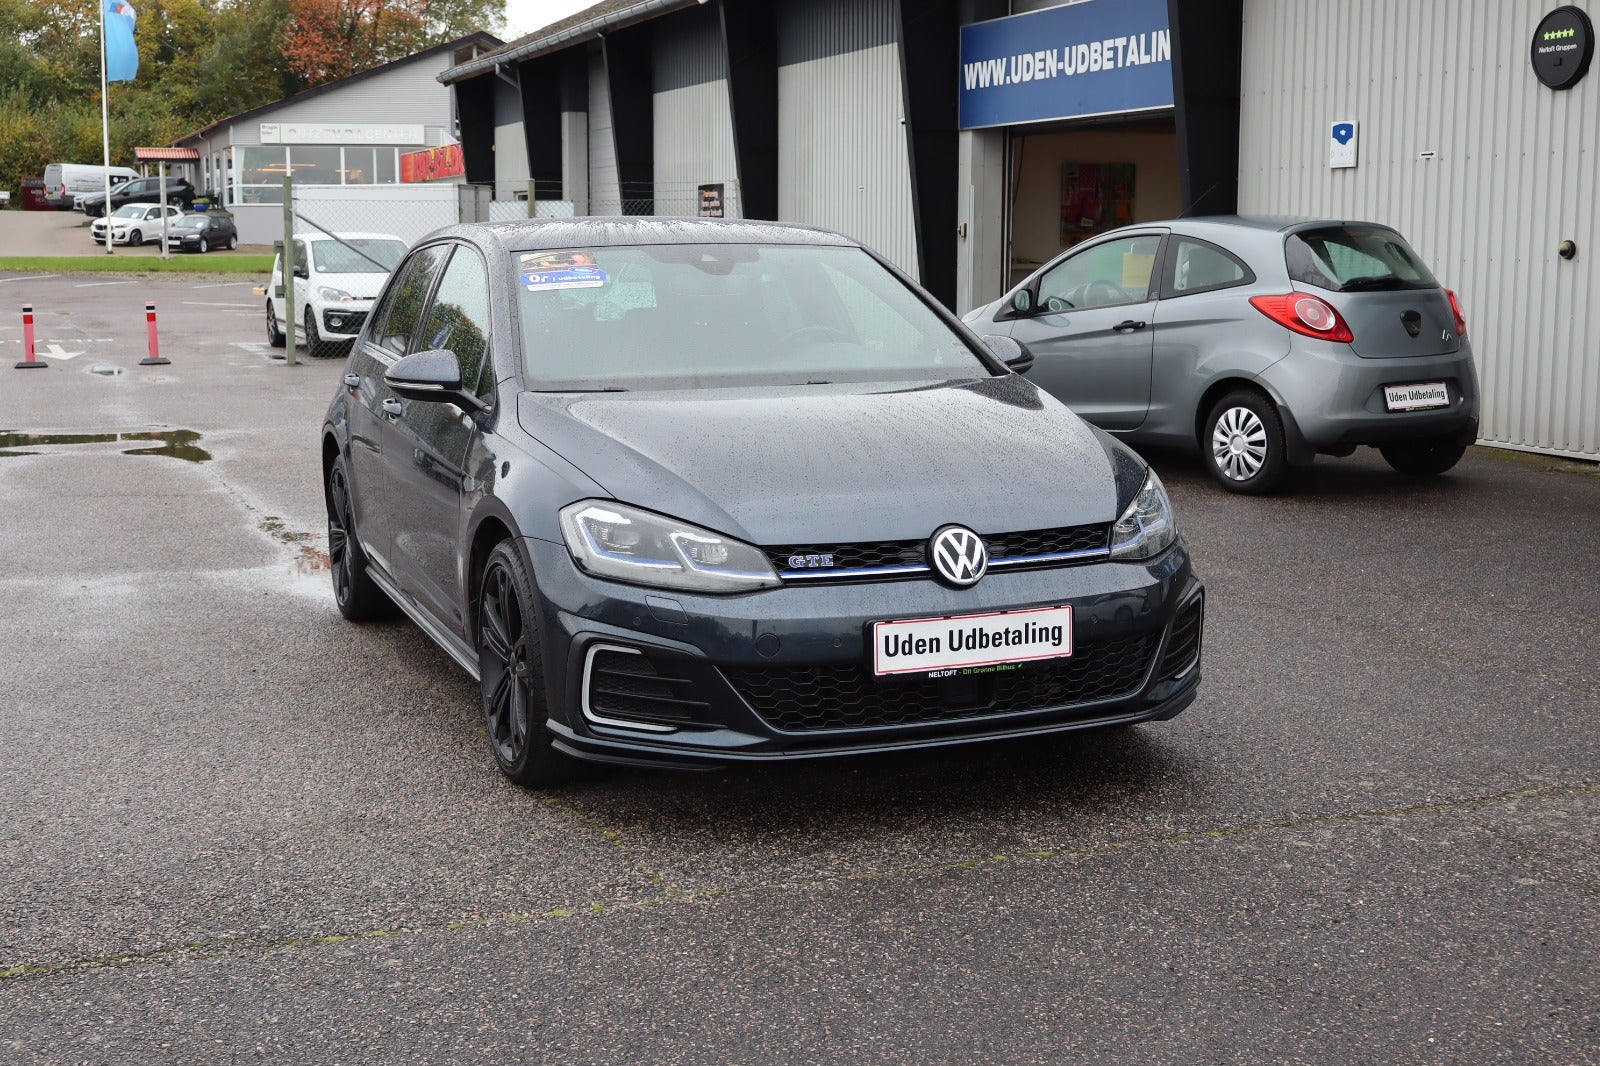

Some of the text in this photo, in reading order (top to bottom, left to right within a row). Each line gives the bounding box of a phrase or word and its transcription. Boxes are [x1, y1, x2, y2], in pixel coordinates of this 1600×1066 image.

[1556, 44, 1577, 52] Gruppen
[1389, 389, 1445, 402] Uden Udbetaling
[788, 553, 834, 568] GTE
[884, 621, 1063, 658] Uden Udbetaling
[928, 669, 957, 678] NELTOFT
